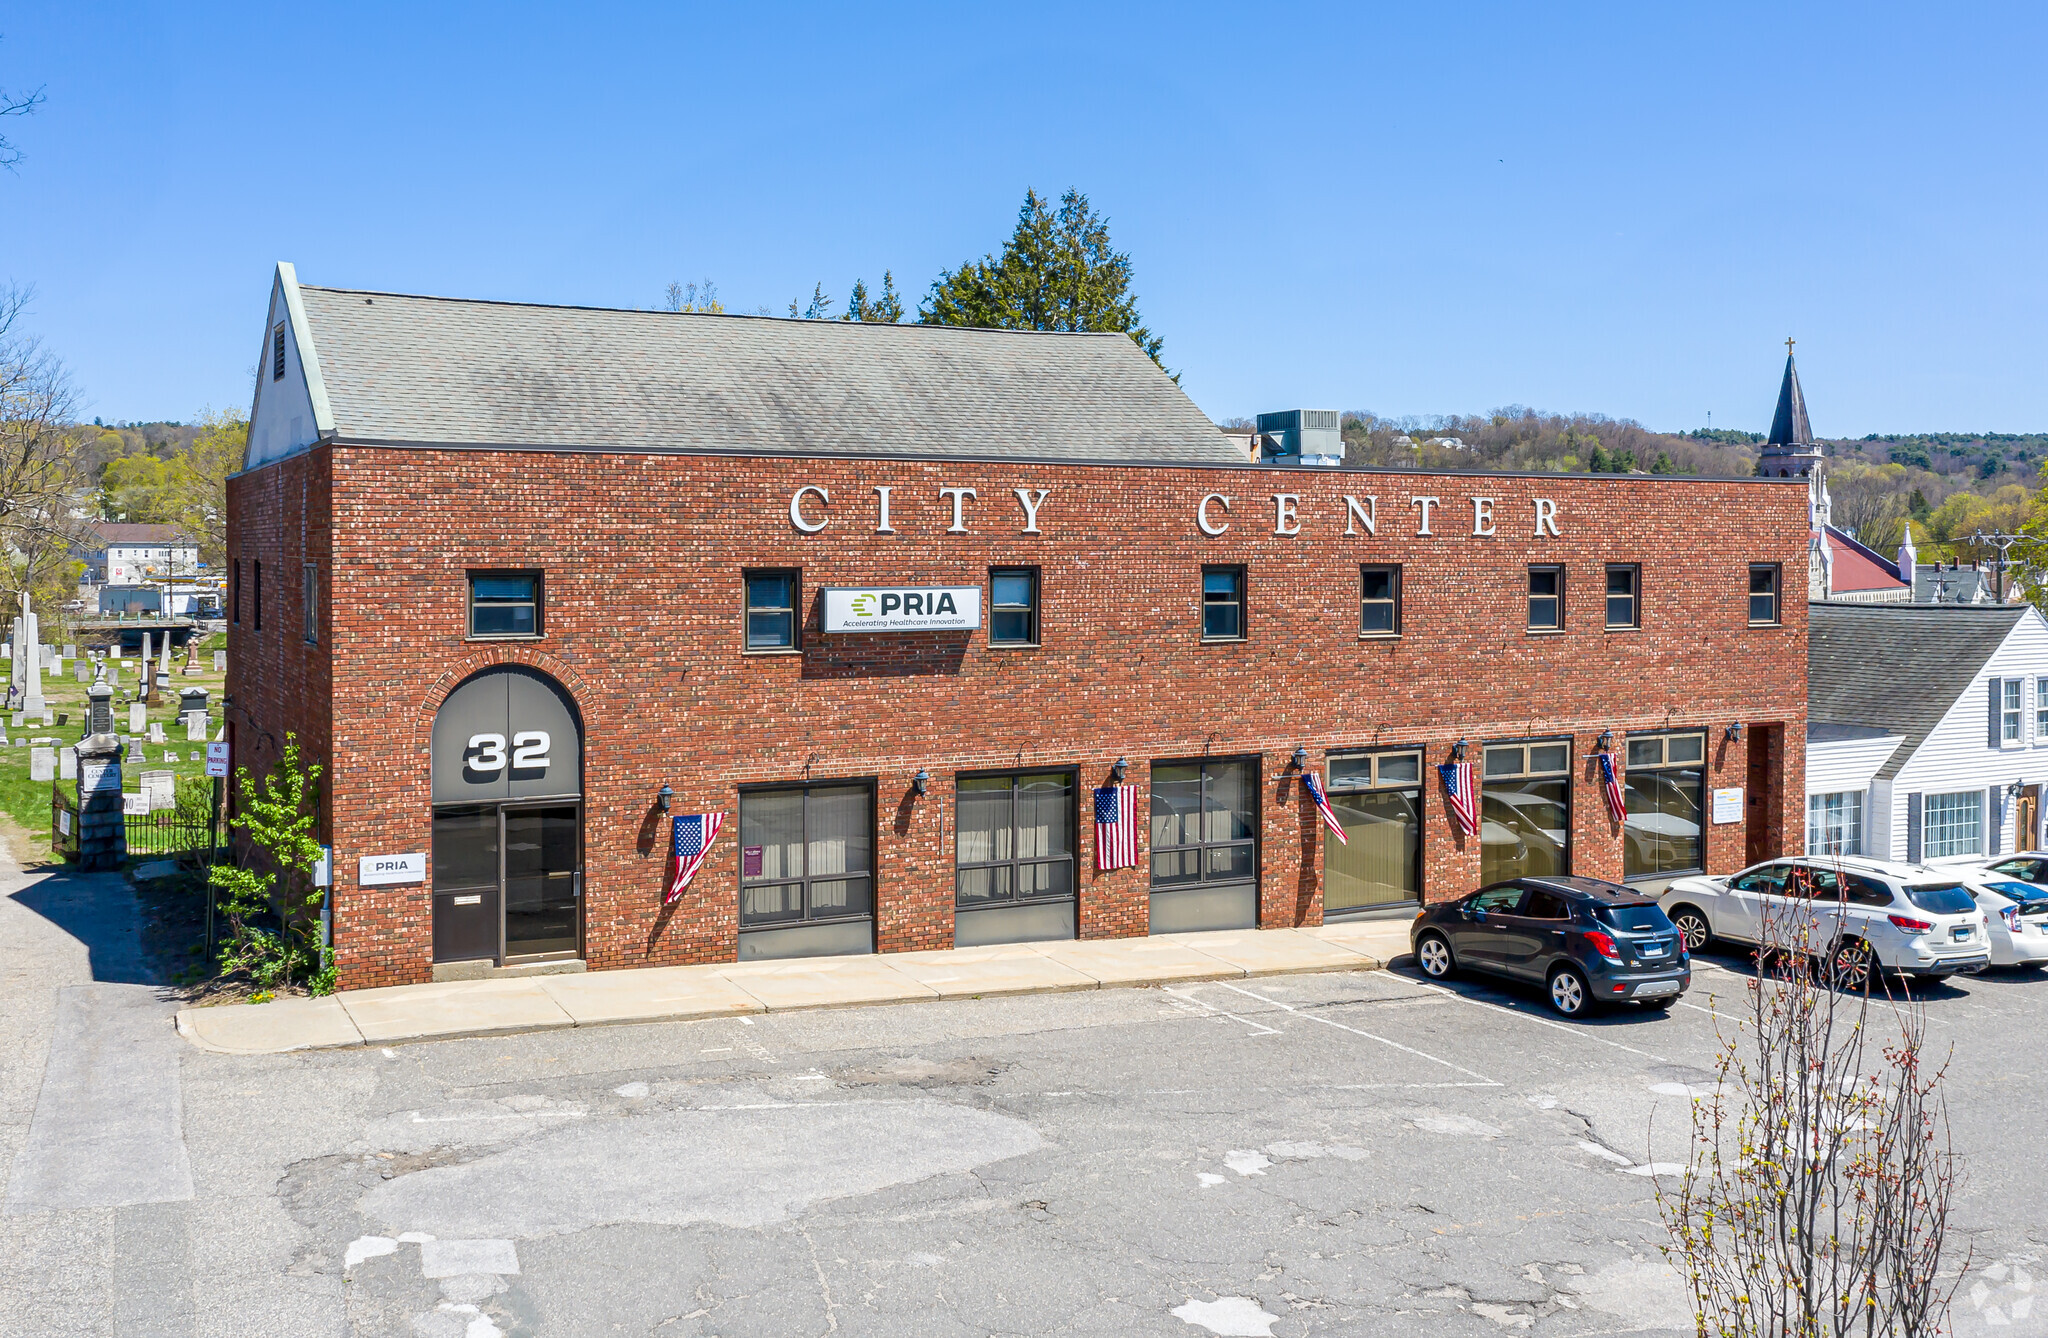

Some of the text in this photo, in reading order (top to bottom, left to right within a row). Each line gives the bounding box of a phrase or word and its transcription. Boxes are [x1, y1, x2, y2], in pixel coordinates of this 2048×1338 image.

[789, 485, 1561, 537] CITY CENTER
[880, 592, 958, 616] PRIA
[842, 619, 888, 628] Accelerating
[889, 618, 928, 626] Healthcare
[468, 730, 551, 771] 32
[375, 860, 408, 871] PRIA
